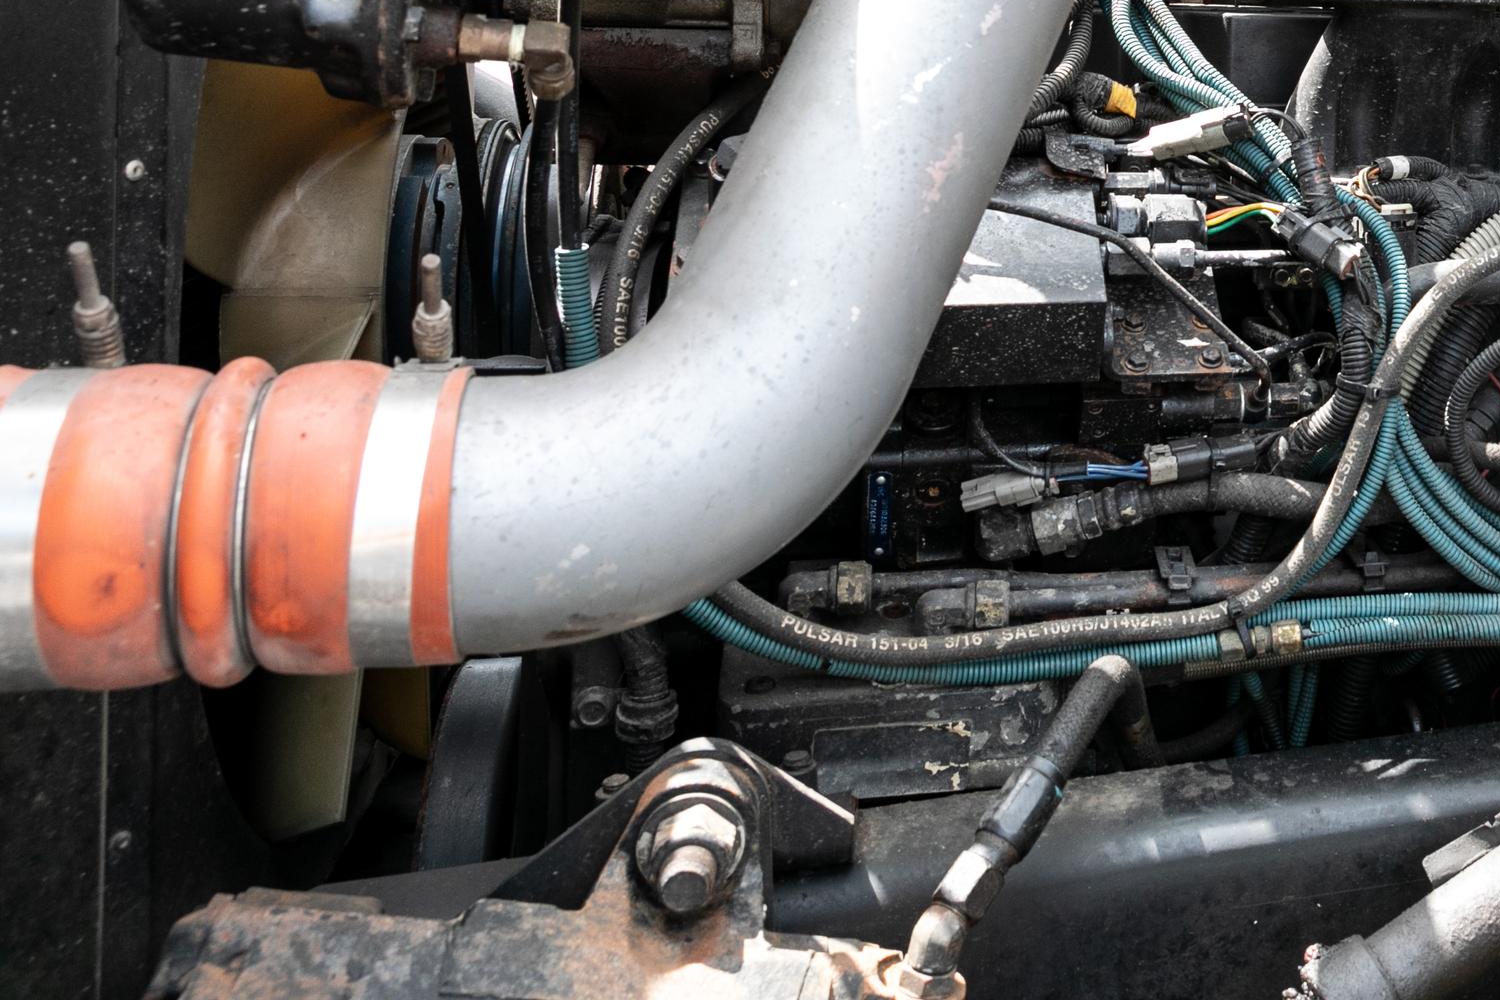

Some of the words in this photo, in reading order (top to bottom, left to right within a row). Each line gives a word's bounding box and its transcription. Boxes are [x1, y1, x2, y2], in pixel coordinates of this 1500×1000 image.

[613, 275, 634, 350] SAE100
[781, 615, 858, 648] PULSAR
[870, 637, 928, 650] 151-04
[944, 632, 990, 649] 3/16"
[1262, 575, 1280, 594] 99
